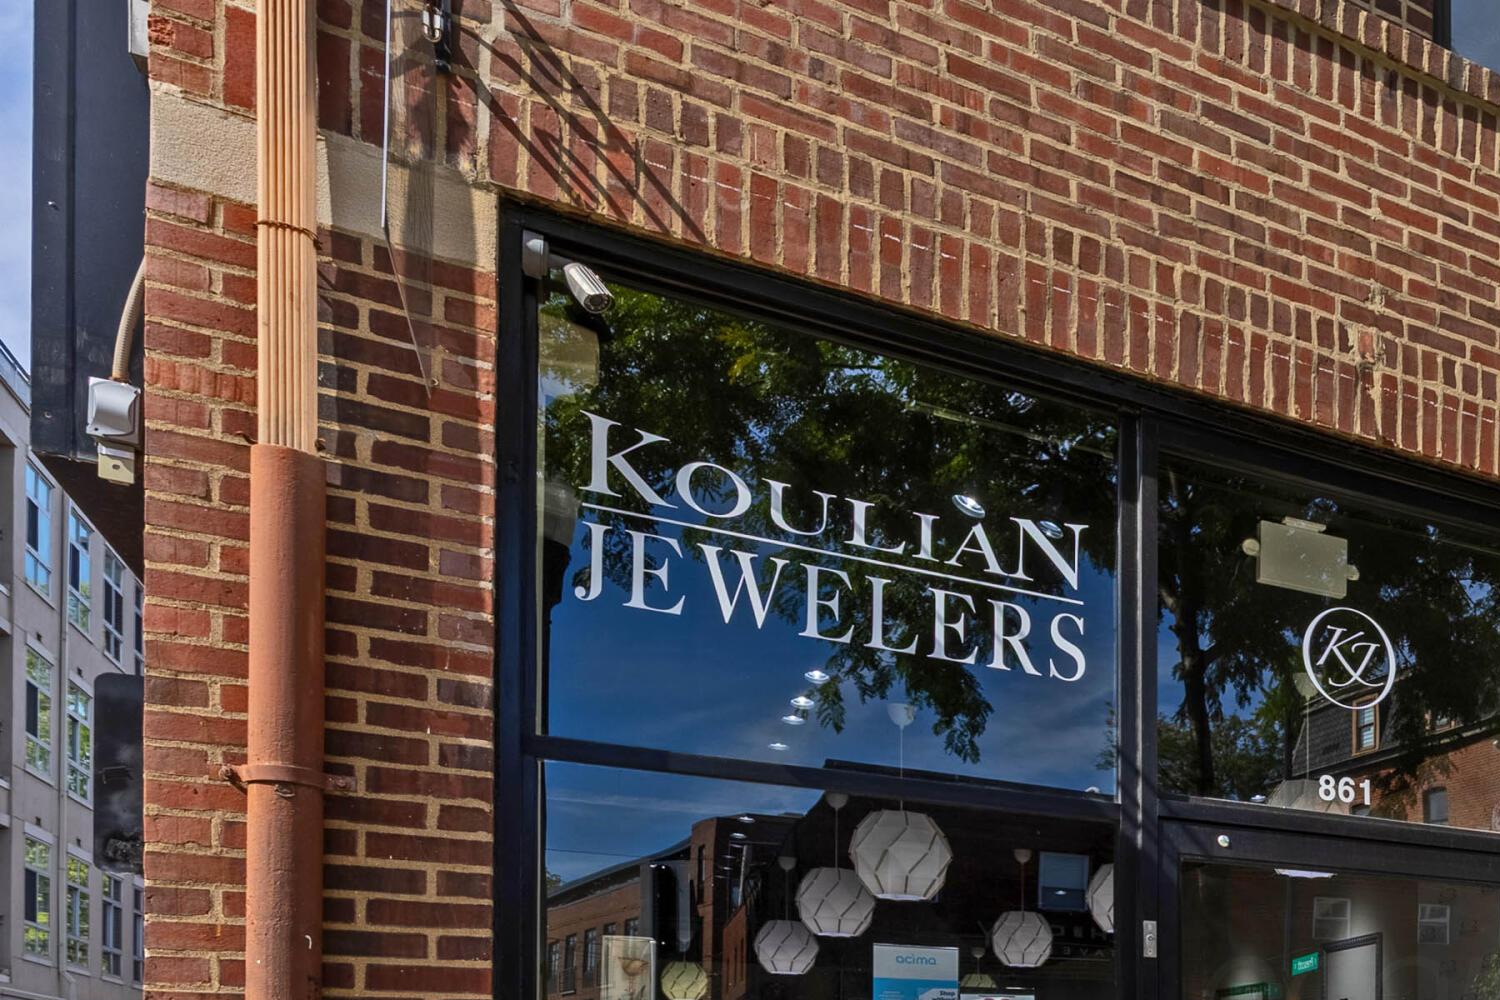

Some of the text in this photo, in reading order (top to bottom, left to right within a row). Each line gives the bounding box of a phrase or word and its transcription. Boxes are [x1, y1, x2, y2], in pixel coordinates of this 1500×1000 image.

[579, 408, 1089, 592] KOULIAN
[574, 520, 1087, 683] JEWELERS
[1318, 773, 1372, 806] 861
[895, 953, 937, 966] acima
